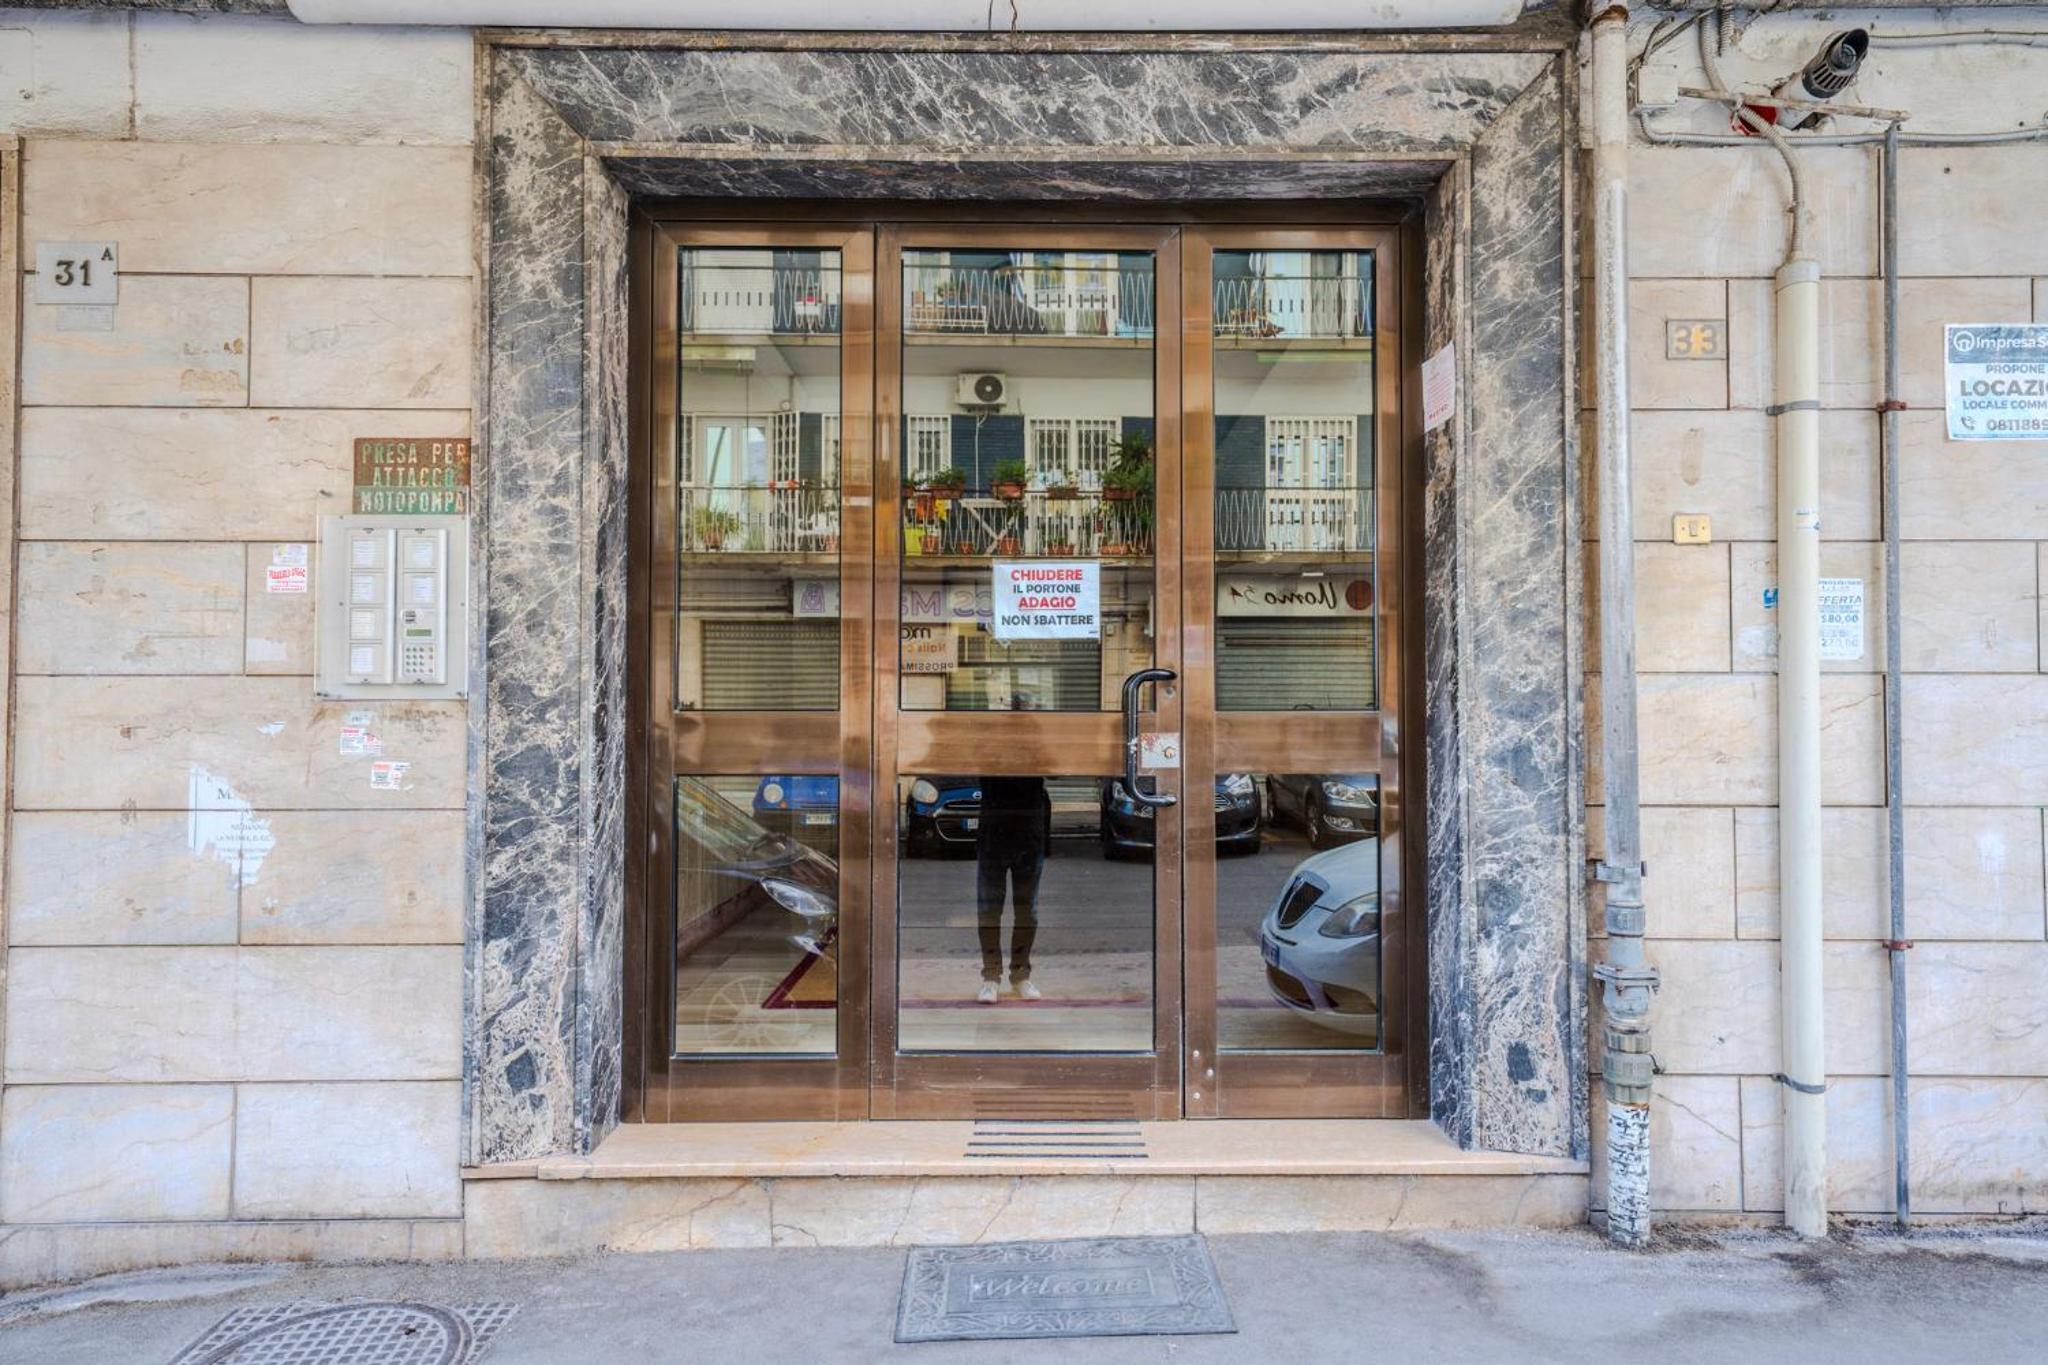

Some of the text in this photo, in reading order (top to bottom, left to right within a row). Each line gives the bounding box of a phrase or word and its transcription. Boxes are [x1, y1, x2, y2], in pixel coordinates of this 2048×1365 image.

[55, 246, 114, 287] 31 A
[1674, 325, 1718, 354] 33
[1986, 364, 2046, 374] PROPONE
[1961, 380, 2048, 396] LOCAZI
[1963, 400, 2008, 410] LOCALE
[362, 443, 469, 464] PRESA PER
[373, 466, 455, 488] ATTACCO
[361, 491, 464, 513] MOTOPOMPA
[1011, 569, 1083, 581] CHIUDERE
[1013, 584, 1081, 593] IL PORTONE
[1018, 596, 1076, 608] ADAGIO
[1001, 615, 1094, 625] NON SBATTERE
